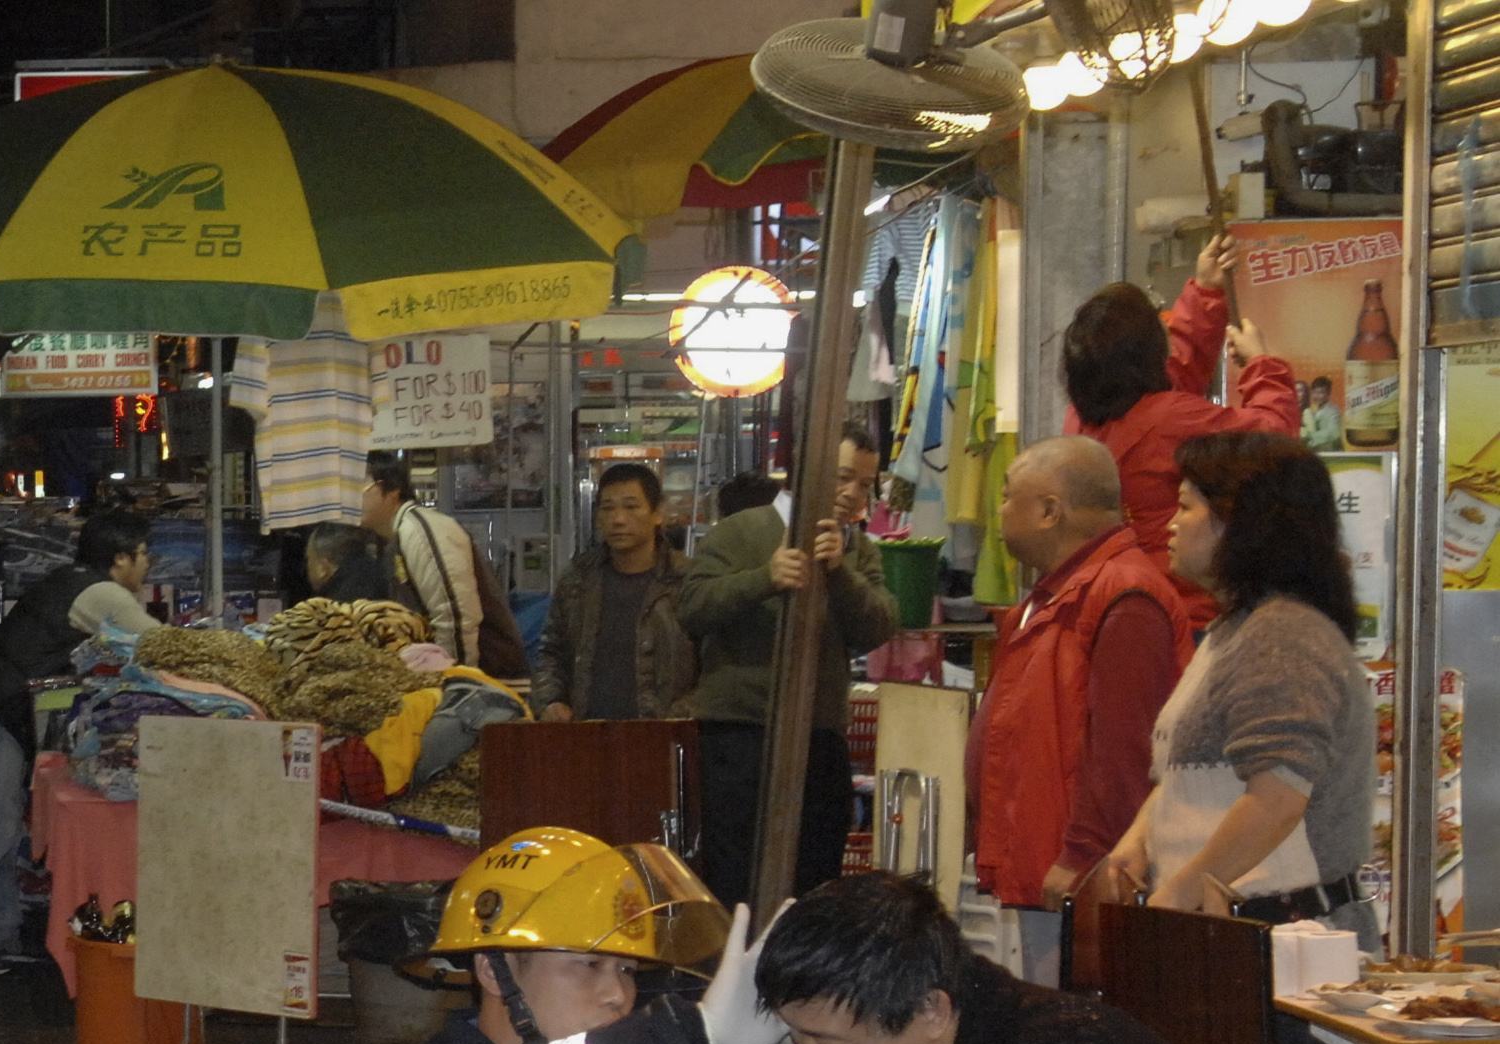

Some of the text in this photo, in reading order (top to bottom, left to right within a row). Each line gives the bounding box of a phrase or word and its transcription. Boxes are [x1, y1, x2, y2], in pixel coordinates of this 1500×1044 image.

[81, 222, 242, 257] 农产品
[393, 375, 438, 401] FOR
[393, 406, 434, 428] FOR
[484, 853, 541, 871] YMT
